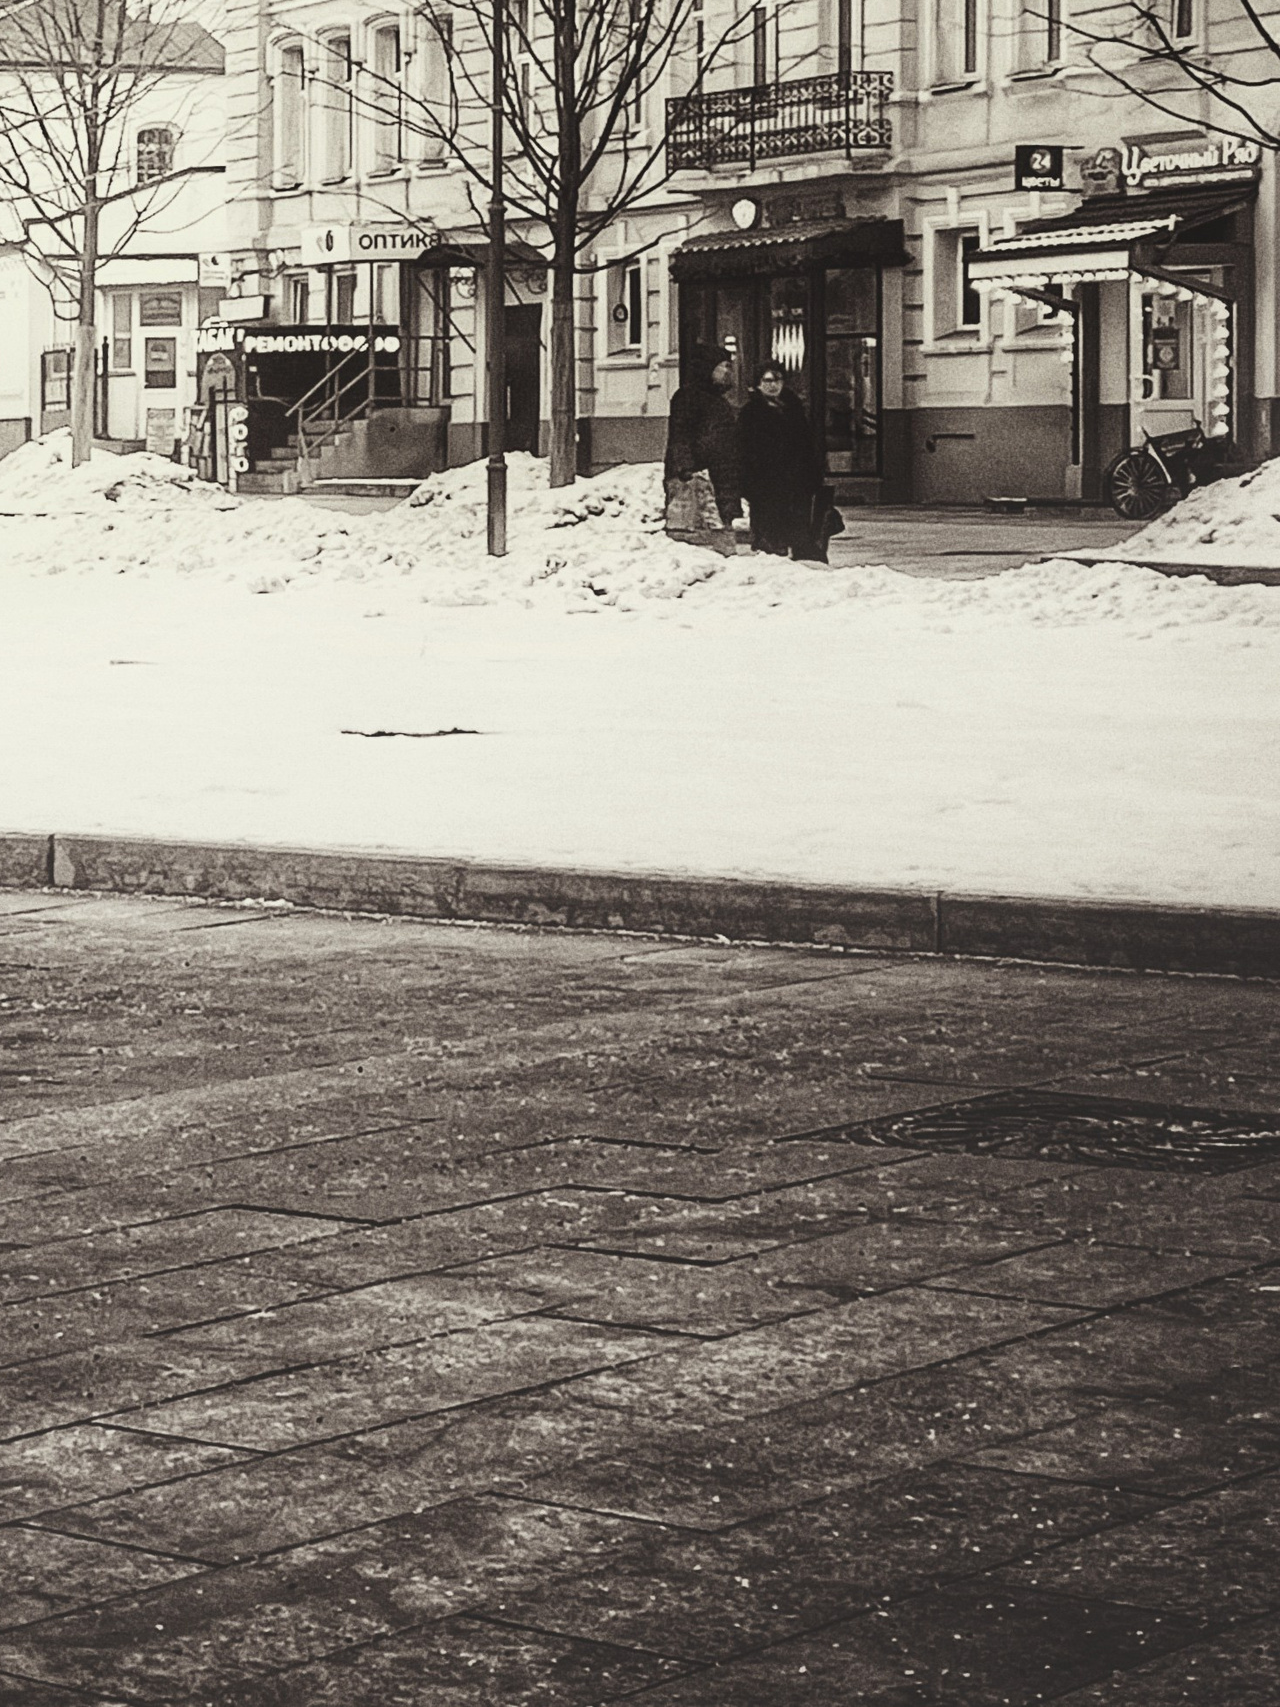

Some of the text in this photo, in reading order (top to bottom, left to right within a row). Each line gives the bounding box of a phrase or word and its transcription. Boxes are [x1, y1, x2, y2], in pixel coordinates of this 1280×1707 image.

[1222, 136, 1258, 165] Ряд
[1032, 153, 1051, 170] 24
[245, 334, 322, 353] РЕМОНТ
